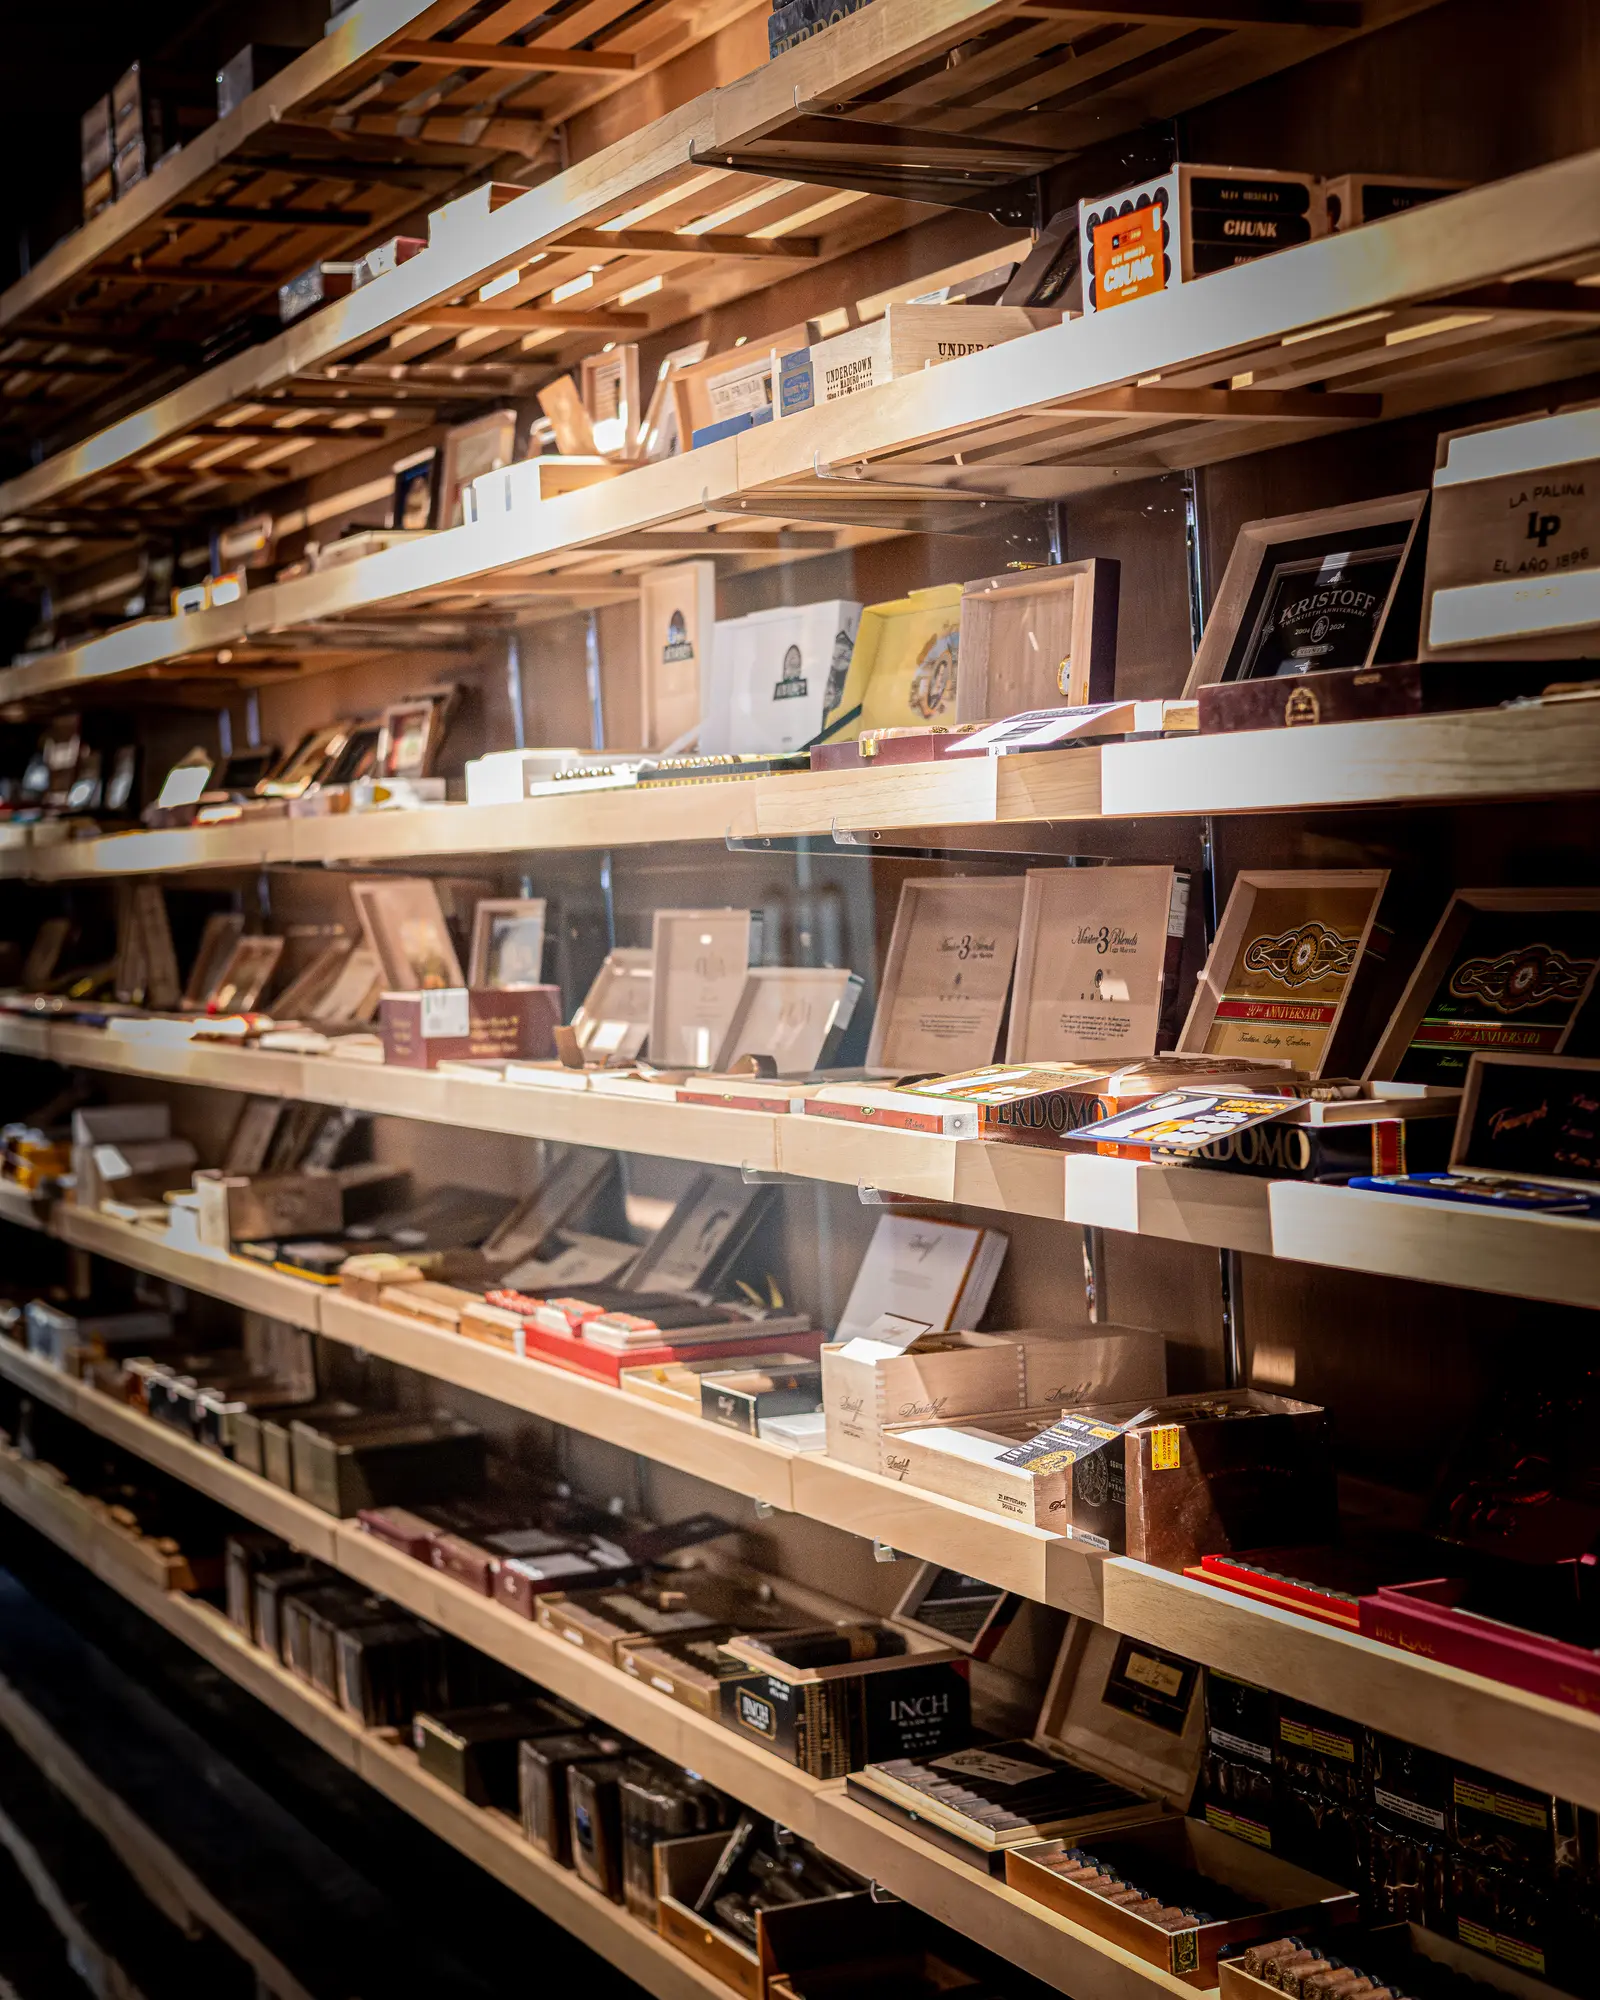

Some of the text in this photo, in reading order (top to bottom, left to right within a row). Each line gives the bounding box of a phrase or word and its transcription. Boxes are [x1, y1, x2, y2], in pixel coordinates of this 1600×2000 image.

[1223, 219, 1278, 238] CHUNK
[1103, 254, 1155, 293] CHUNK
[825, 356, 873, 384] UNDERCROWN
[840, 375, 860, 389] MADURO
[1509, 483, 1585, 509] LA PALINA
[1525, 511, 1561, 548] LP
[1493, 547, 1589, 573] EL AÑO 1896
[1278, 589, 1376, 625] KRISTOFF
[1281, 607, 1367, 628] TWENTIETH ANNIVERSARY
[1329, 623, 1346, 632] 2024
[1097, 926, 1109, 954] 3
[1263, 1006, 1325, 1020] ANNIVERSARY
[1470, 1030, 1541, 1044] ANNIVERSARY
[889, 1693, 950, 1721] INCH
